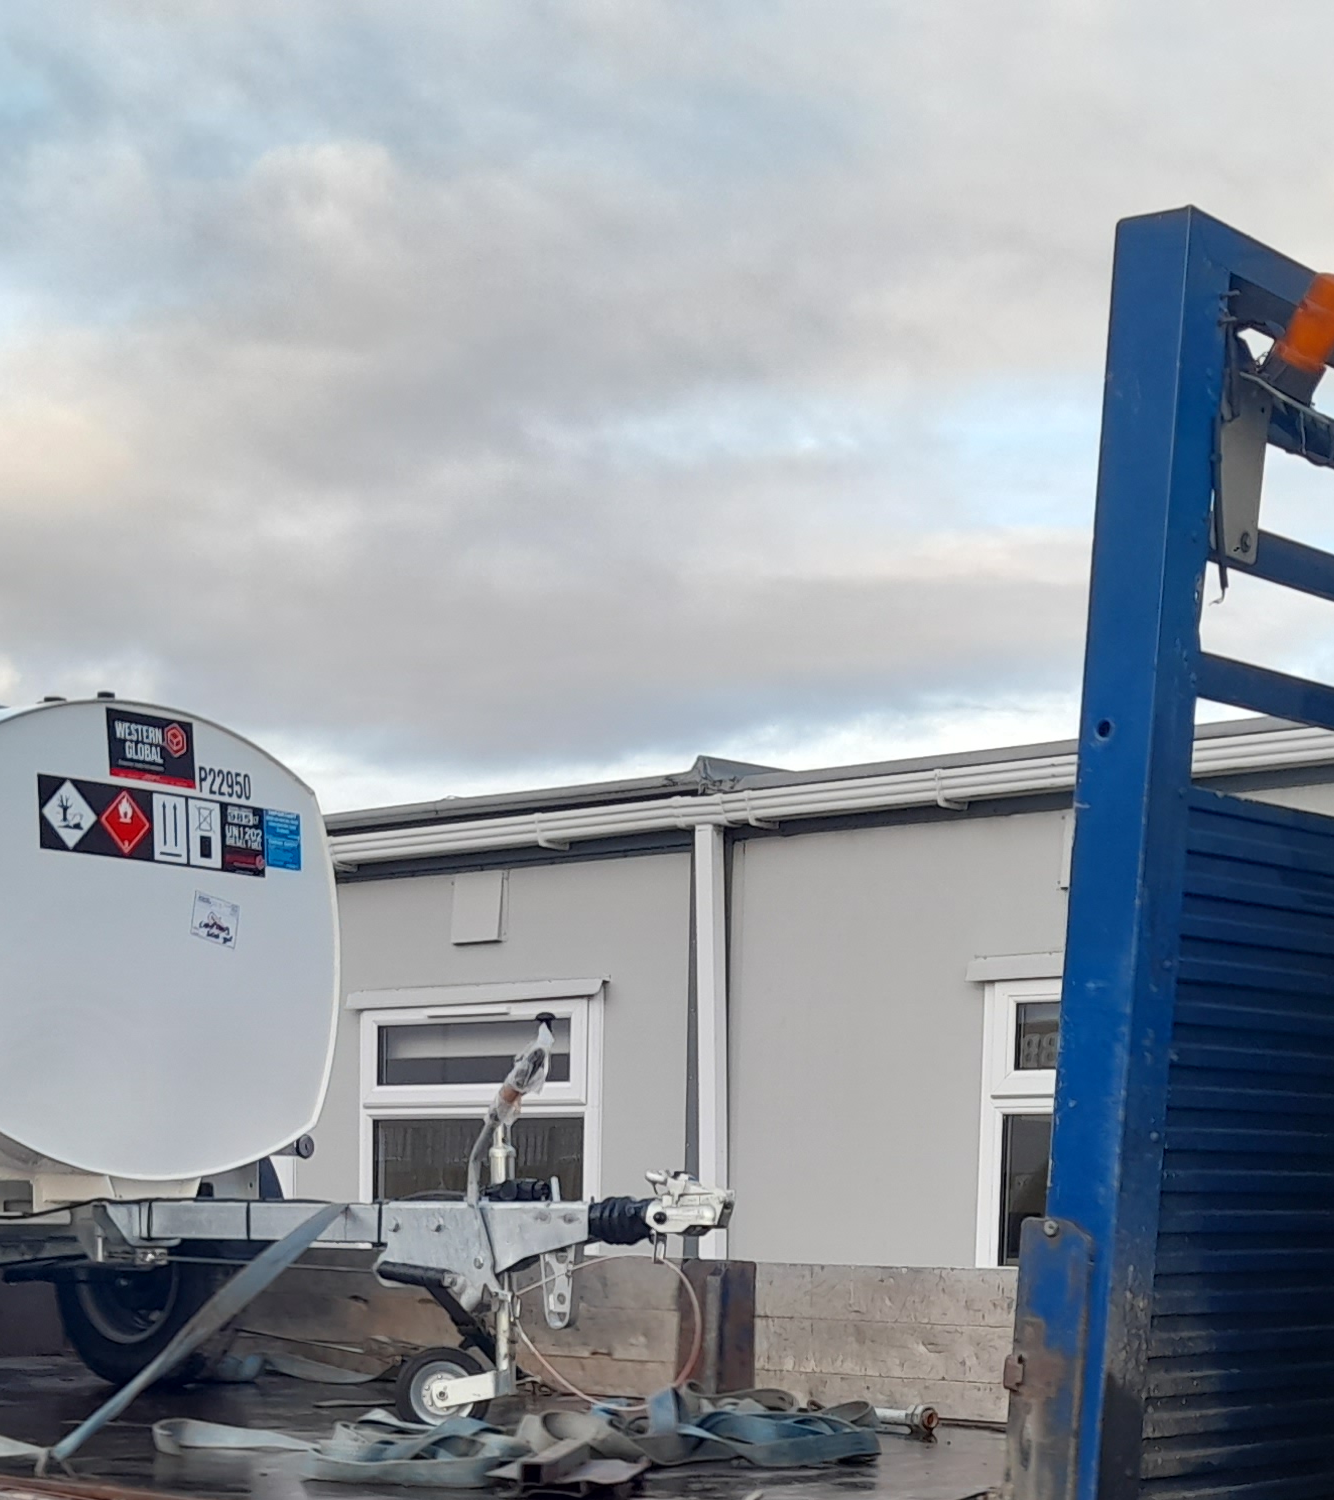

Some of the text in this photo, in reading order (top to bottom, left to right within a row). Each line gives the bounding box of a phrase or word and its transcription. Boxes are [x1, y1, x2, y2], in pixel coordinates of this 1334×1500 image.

[113, 719, 163, 746] WESTERN
[124, 741, 164, 764] GLOBAL
[198, 765, 252, 801] P22950
[224, 823, 263, 841] UN1202
